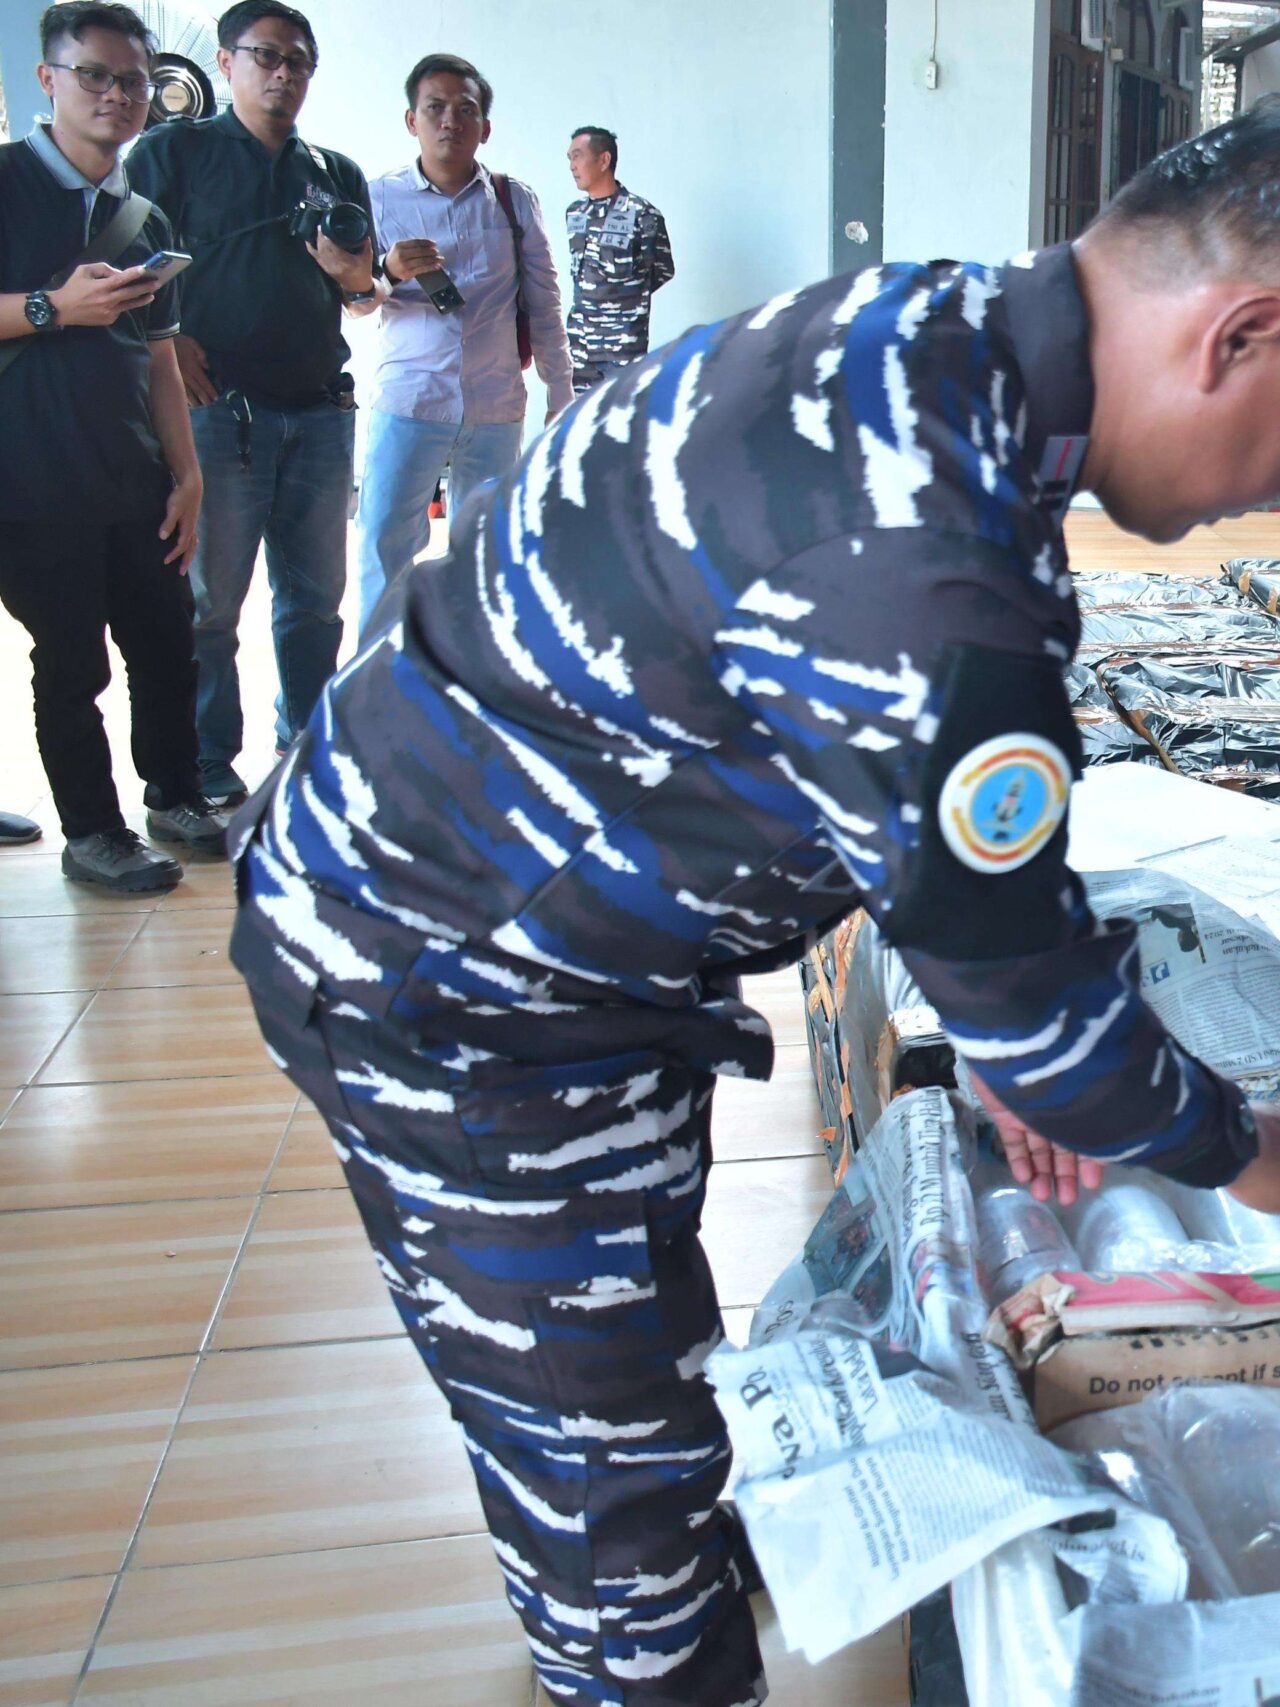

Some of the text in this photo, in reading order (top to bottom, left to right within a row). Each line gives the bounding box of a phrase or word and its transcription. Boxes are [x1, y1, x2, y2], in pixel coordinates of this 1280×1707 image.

[1089, 1376, 1120, 1395] Do
[1128, 1373, 1164, 1392] not
[1252, 1362, 1267, 1381] if
